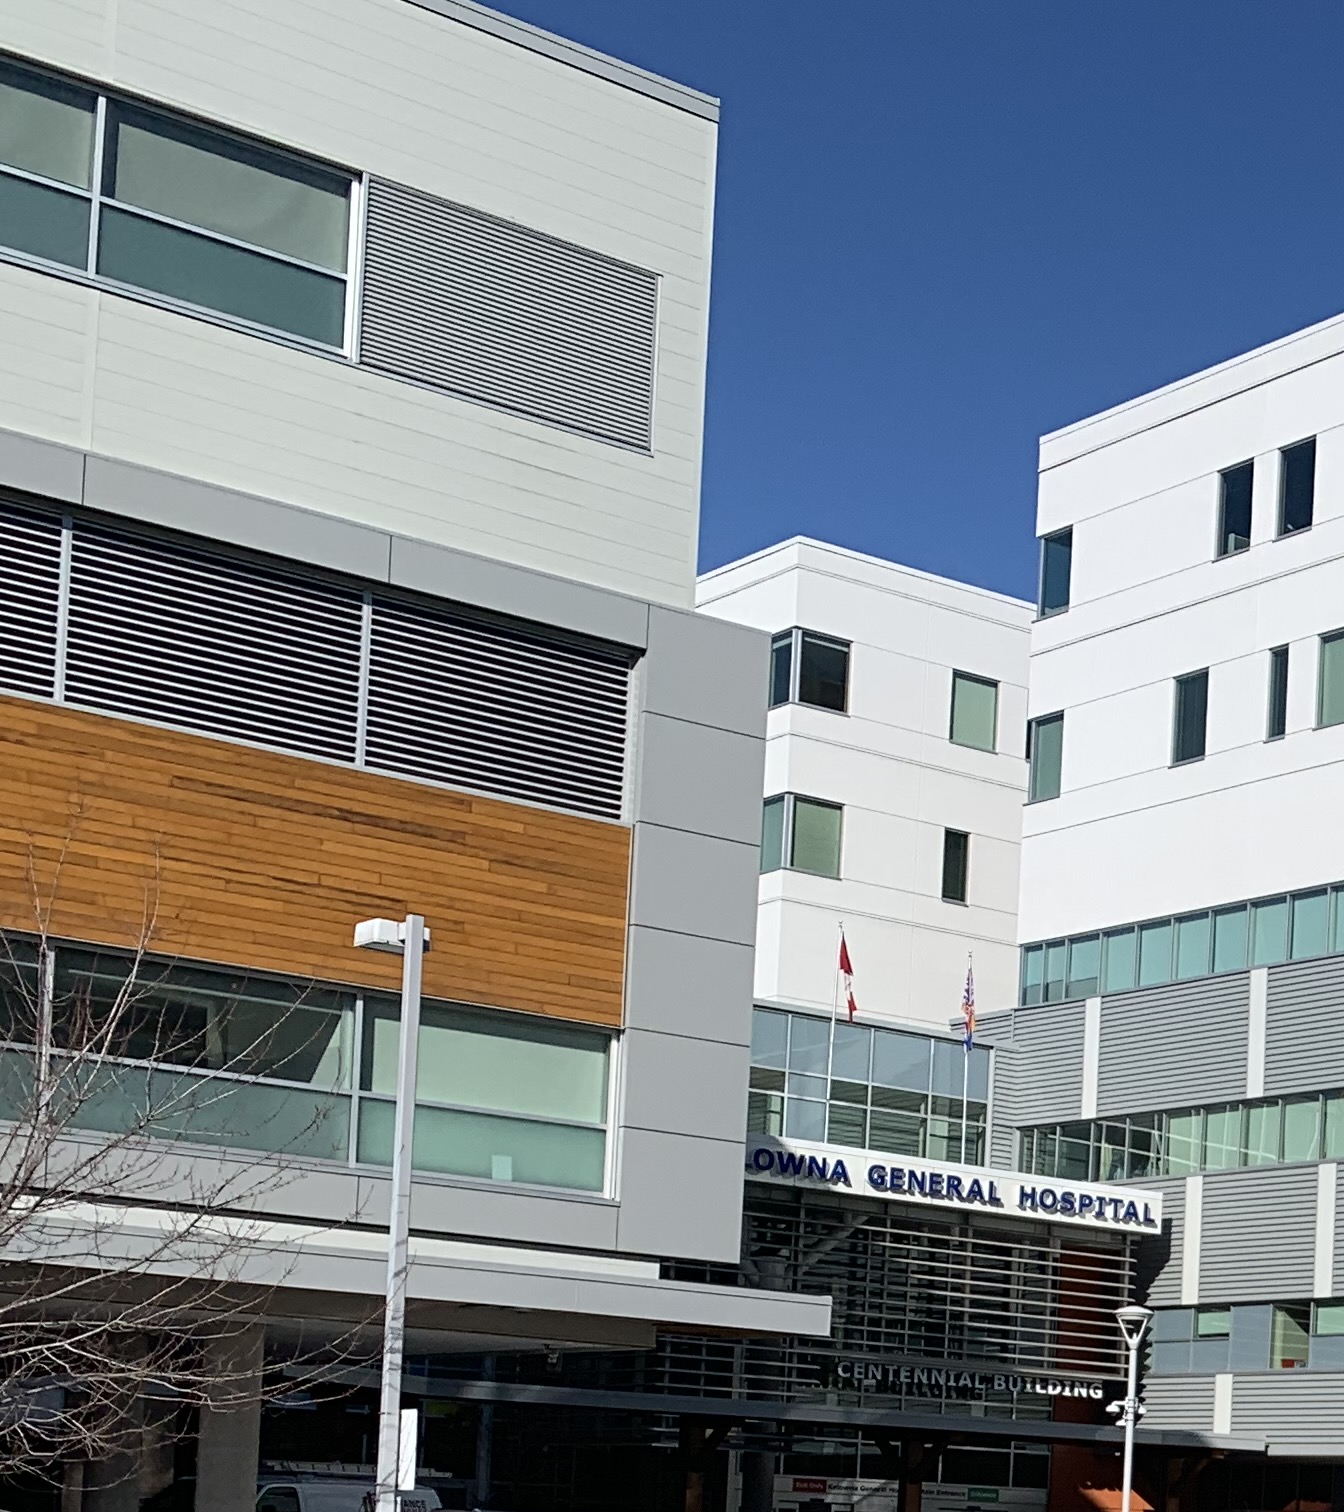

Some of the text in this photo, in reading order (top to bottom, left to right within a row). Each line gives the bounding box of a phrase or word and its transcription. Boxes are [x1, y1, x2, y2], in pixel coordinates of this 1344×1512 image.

[867, 1164, 1001, 1204] GENERAL
[1019, 1185, 1156, 1224] HOSPITAL
[838, 1361, 1104, 1399] CENTENNIAL BUILDING
